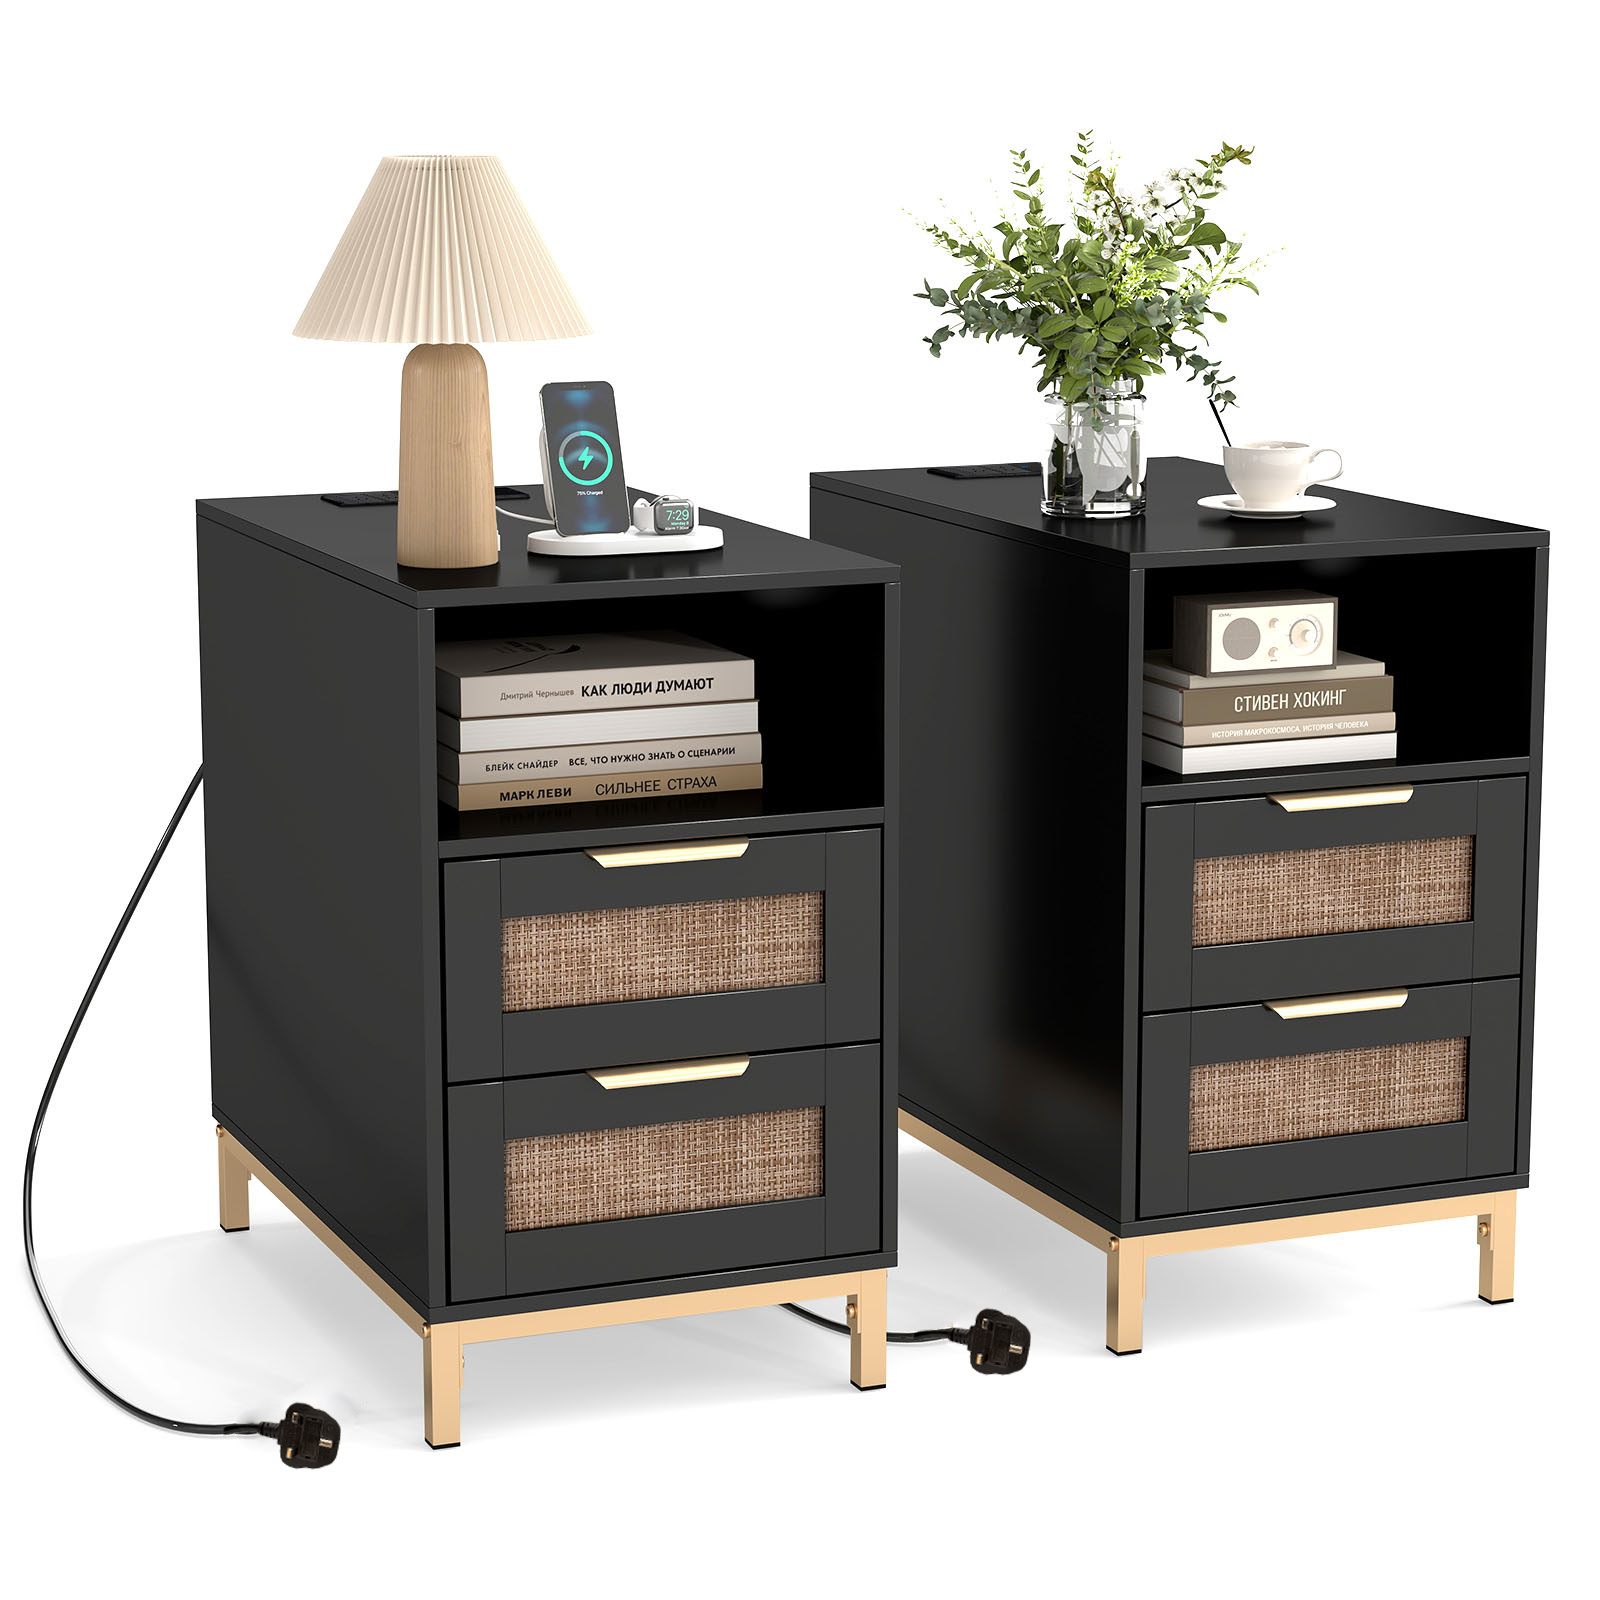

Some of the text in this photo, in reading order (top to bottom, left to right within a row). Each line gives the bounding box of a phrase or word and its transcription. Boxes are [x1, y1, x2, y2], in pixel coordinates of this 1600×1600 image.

[666, 509, 690, 521] 7:29
[500, 677, 715, 701] Дмитрий Чернышев КАК ЛЮДИ ДУМАЮТ
[1234, 689, 1347, 713] СТИВЕН ХОКИНГ
[1211, 729, 1244, 739] ИСТОРИЯ
[1302, 723, 1334, 732] ИСТОРИЯ
[1334, 720, 1369, 730] ЧЕЛОВЕКА
[485, 746, 736, 772] БЛЕЙК СНАЙДЕР ВСЕ, ЧТО НУЖНО ЗНАТЬ О СЦЕНАРИИ
[499, 775, 718, 802] МАРК ЛЕВИ СИЛЬНЕЕ СТРАХА
